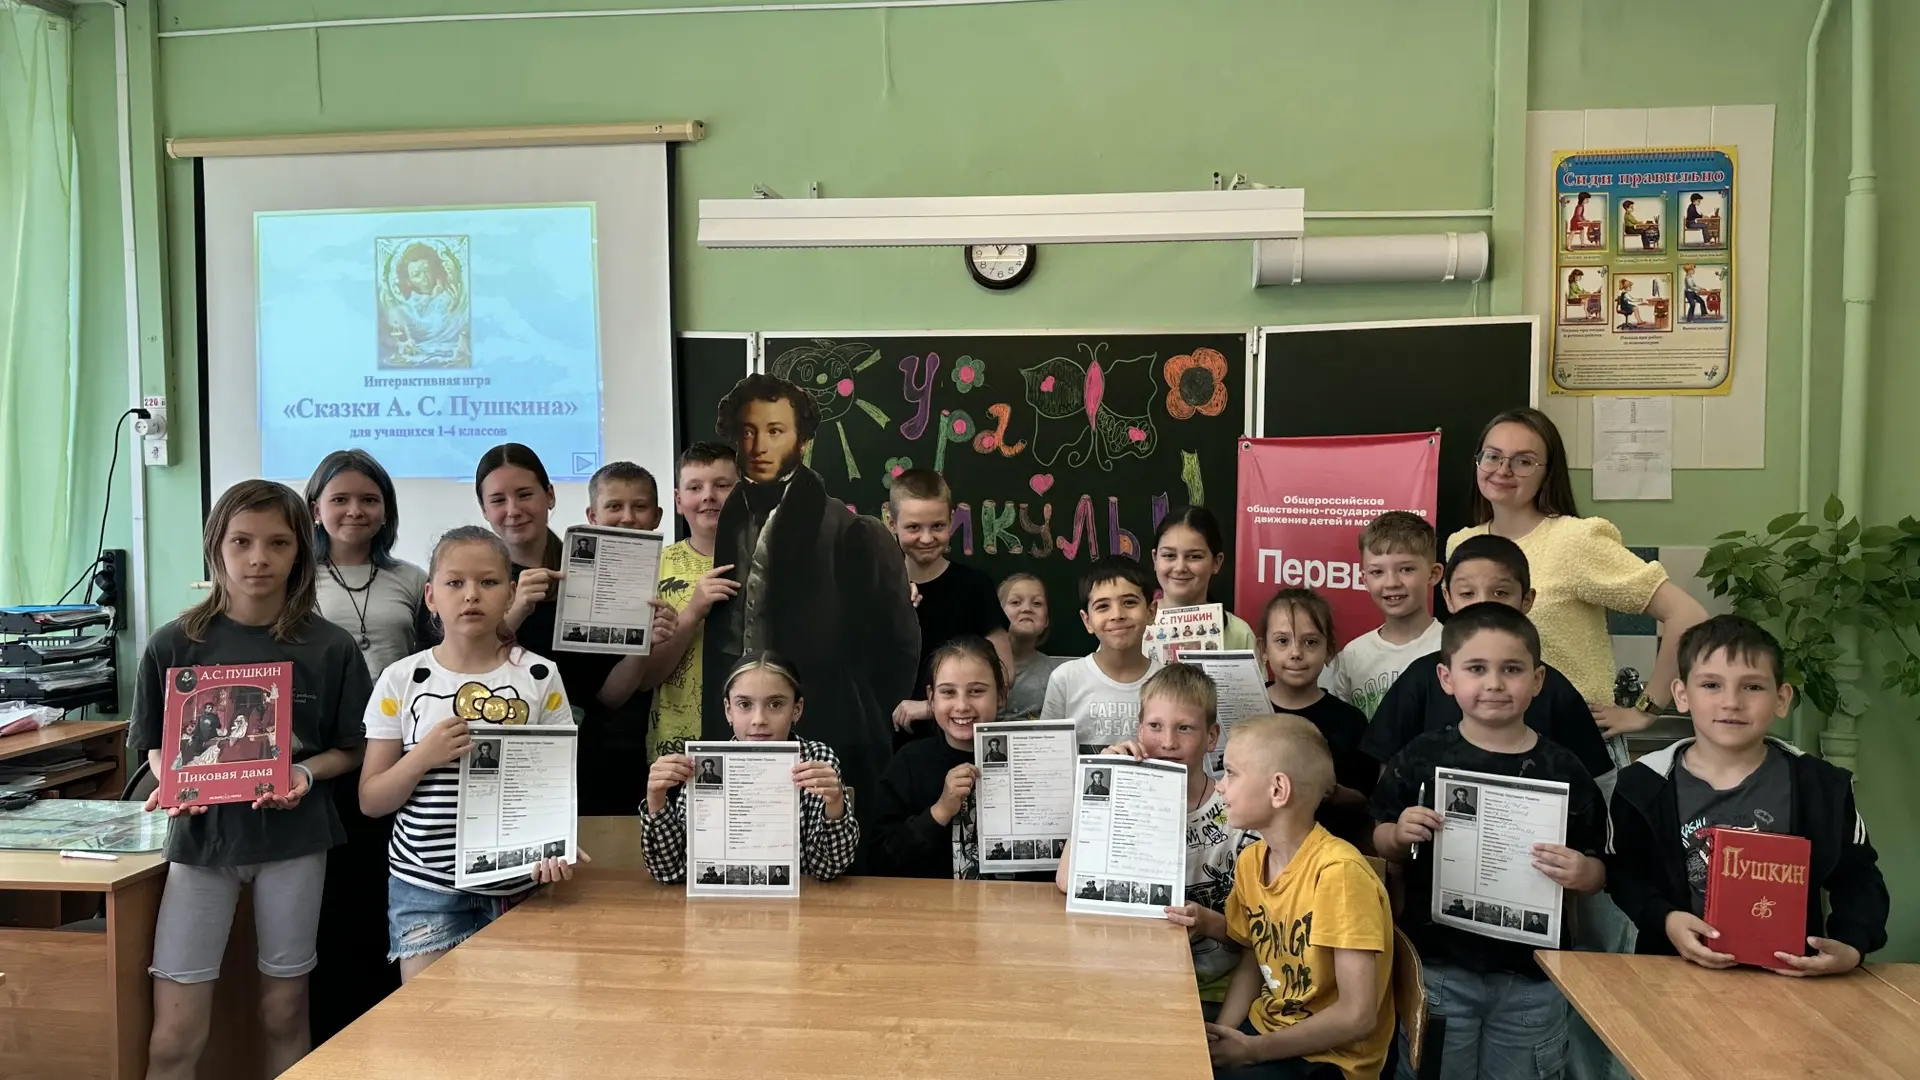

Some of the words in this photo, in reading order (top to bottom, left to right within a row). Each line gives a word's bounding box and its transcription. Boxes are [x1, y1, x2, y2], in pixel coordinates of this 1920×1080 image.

[1563, 172, 1613, 188] Сиди
[1618, 170, 1725, 188] правильно
[976, 250, 983, 258] 9
[1018, 248, 1025, 256] 3
[980, 261, 987, 269] 8
[989, 267, 995, 275] 7
[1008, 267, 1015, 275] 5
[997, 271, 1004, 279] 6
[364, 376, 460, 390] Интерактивная
[461, 377, 491, 388] игра
[283, 397, 380, 419] «Сказки
[386, 396, 411, 417] А.
[417, 397, 442, 417] С.
[451, 396, 578, 421] Пушкина»
[349, 427, 371, 439] для
[373, 426, 434, 439] учащихся
[458, 426, 508, 437] классов
[1283, 495, 1385, 506] Общероссийское
[1246, 504, 1427, 517] общественно-государстое
[1254, 515, 1309, 525] движение
[1309, 516, 1343, 526] детей
[1170, 611, 1213, 625] ПУШКИН
[200, 669, 224, 681] А.С.
[225, 667, 281, 680] ПУШКИН
[177, 770, 237, 784] Пиковая
[240, 767, 273, 779] дама
[1721, 845, 1806, 885] Пушкин
